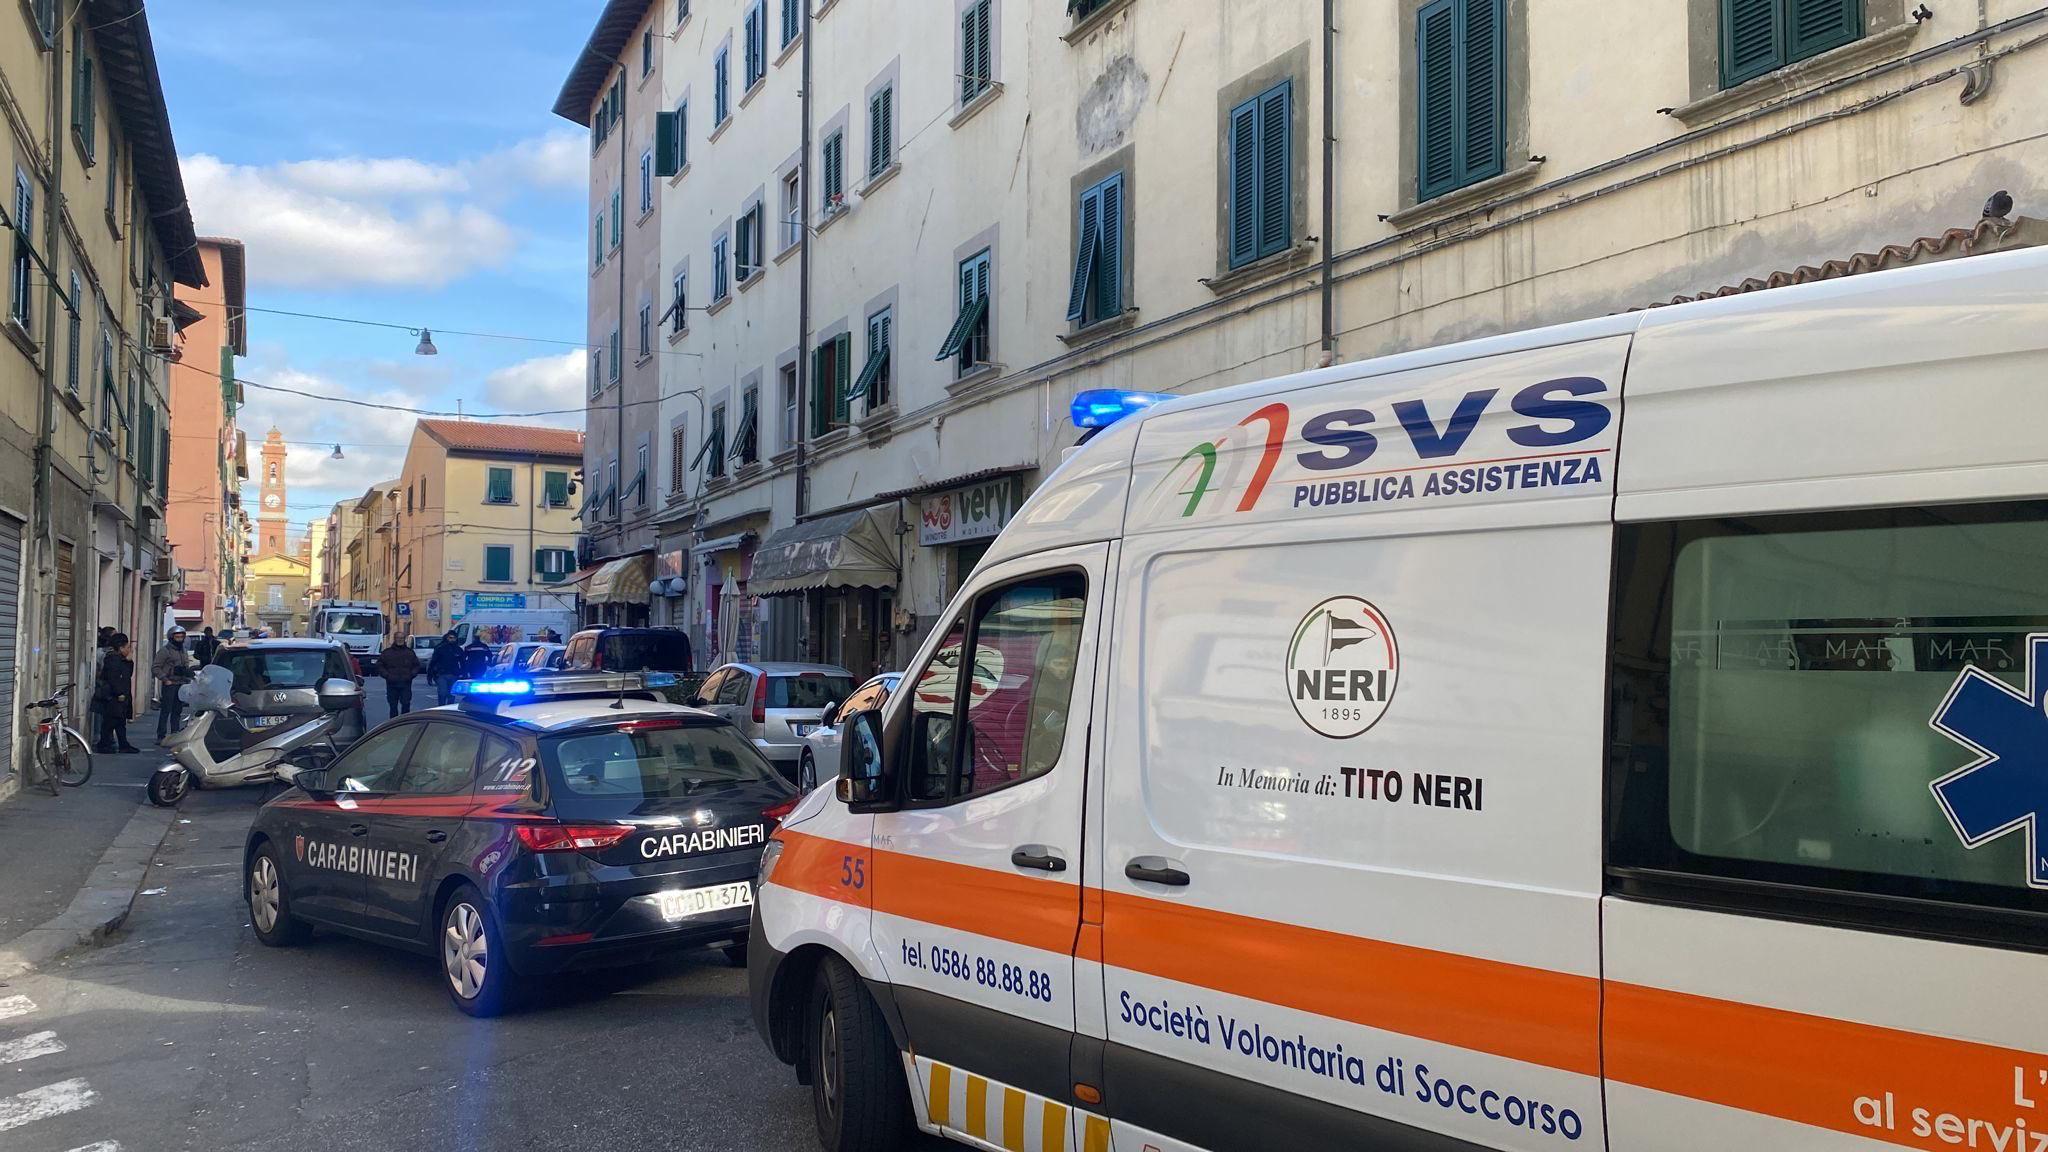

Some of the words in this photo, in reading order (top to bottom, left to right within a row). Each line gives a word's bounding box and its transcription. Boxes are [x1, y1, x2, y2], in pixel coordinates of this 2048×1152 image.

[1296, 376, 1612, 471] SVS
[1293, 475, 1415, 508] PUBBLICA
[1422, 456, 1603, 498] ASSISTENZA
[960, 482, 1009, 530] very
[1296, 669, 1387, 702] NERI
[1321, 707, 1362, 721] 1895
[492, 757, 537, 782] 112
[1216, 766, 1234, 787] In
[1238, 767, 1309, 794] Memoria
[1314, 774, 1338, 797] di:
[1340, 766, 1403, 803] TITO
[1413, 772, 1484, 812] NERI
[640, 822, 765, 859] CARABINIERI
[307, 840, 419, 883] CARABINIERI
[841, 855, 865, 889] 55
[720, 885, 750, 905] 372
[902, 938, 927, 970] tel.
[931, 945, 971, 981] 0586
[976, 956, 1052, 1003] 88.88.88
[1119, 990, 1211, 1045] Società
[1217, 1014, 1366, 1087] Volontaria
[1376, 1056, 1405, 1097] di
[1415, 1063, 1583, 1141] Soccorso
[1853, 1091, 1895, 1131] al
